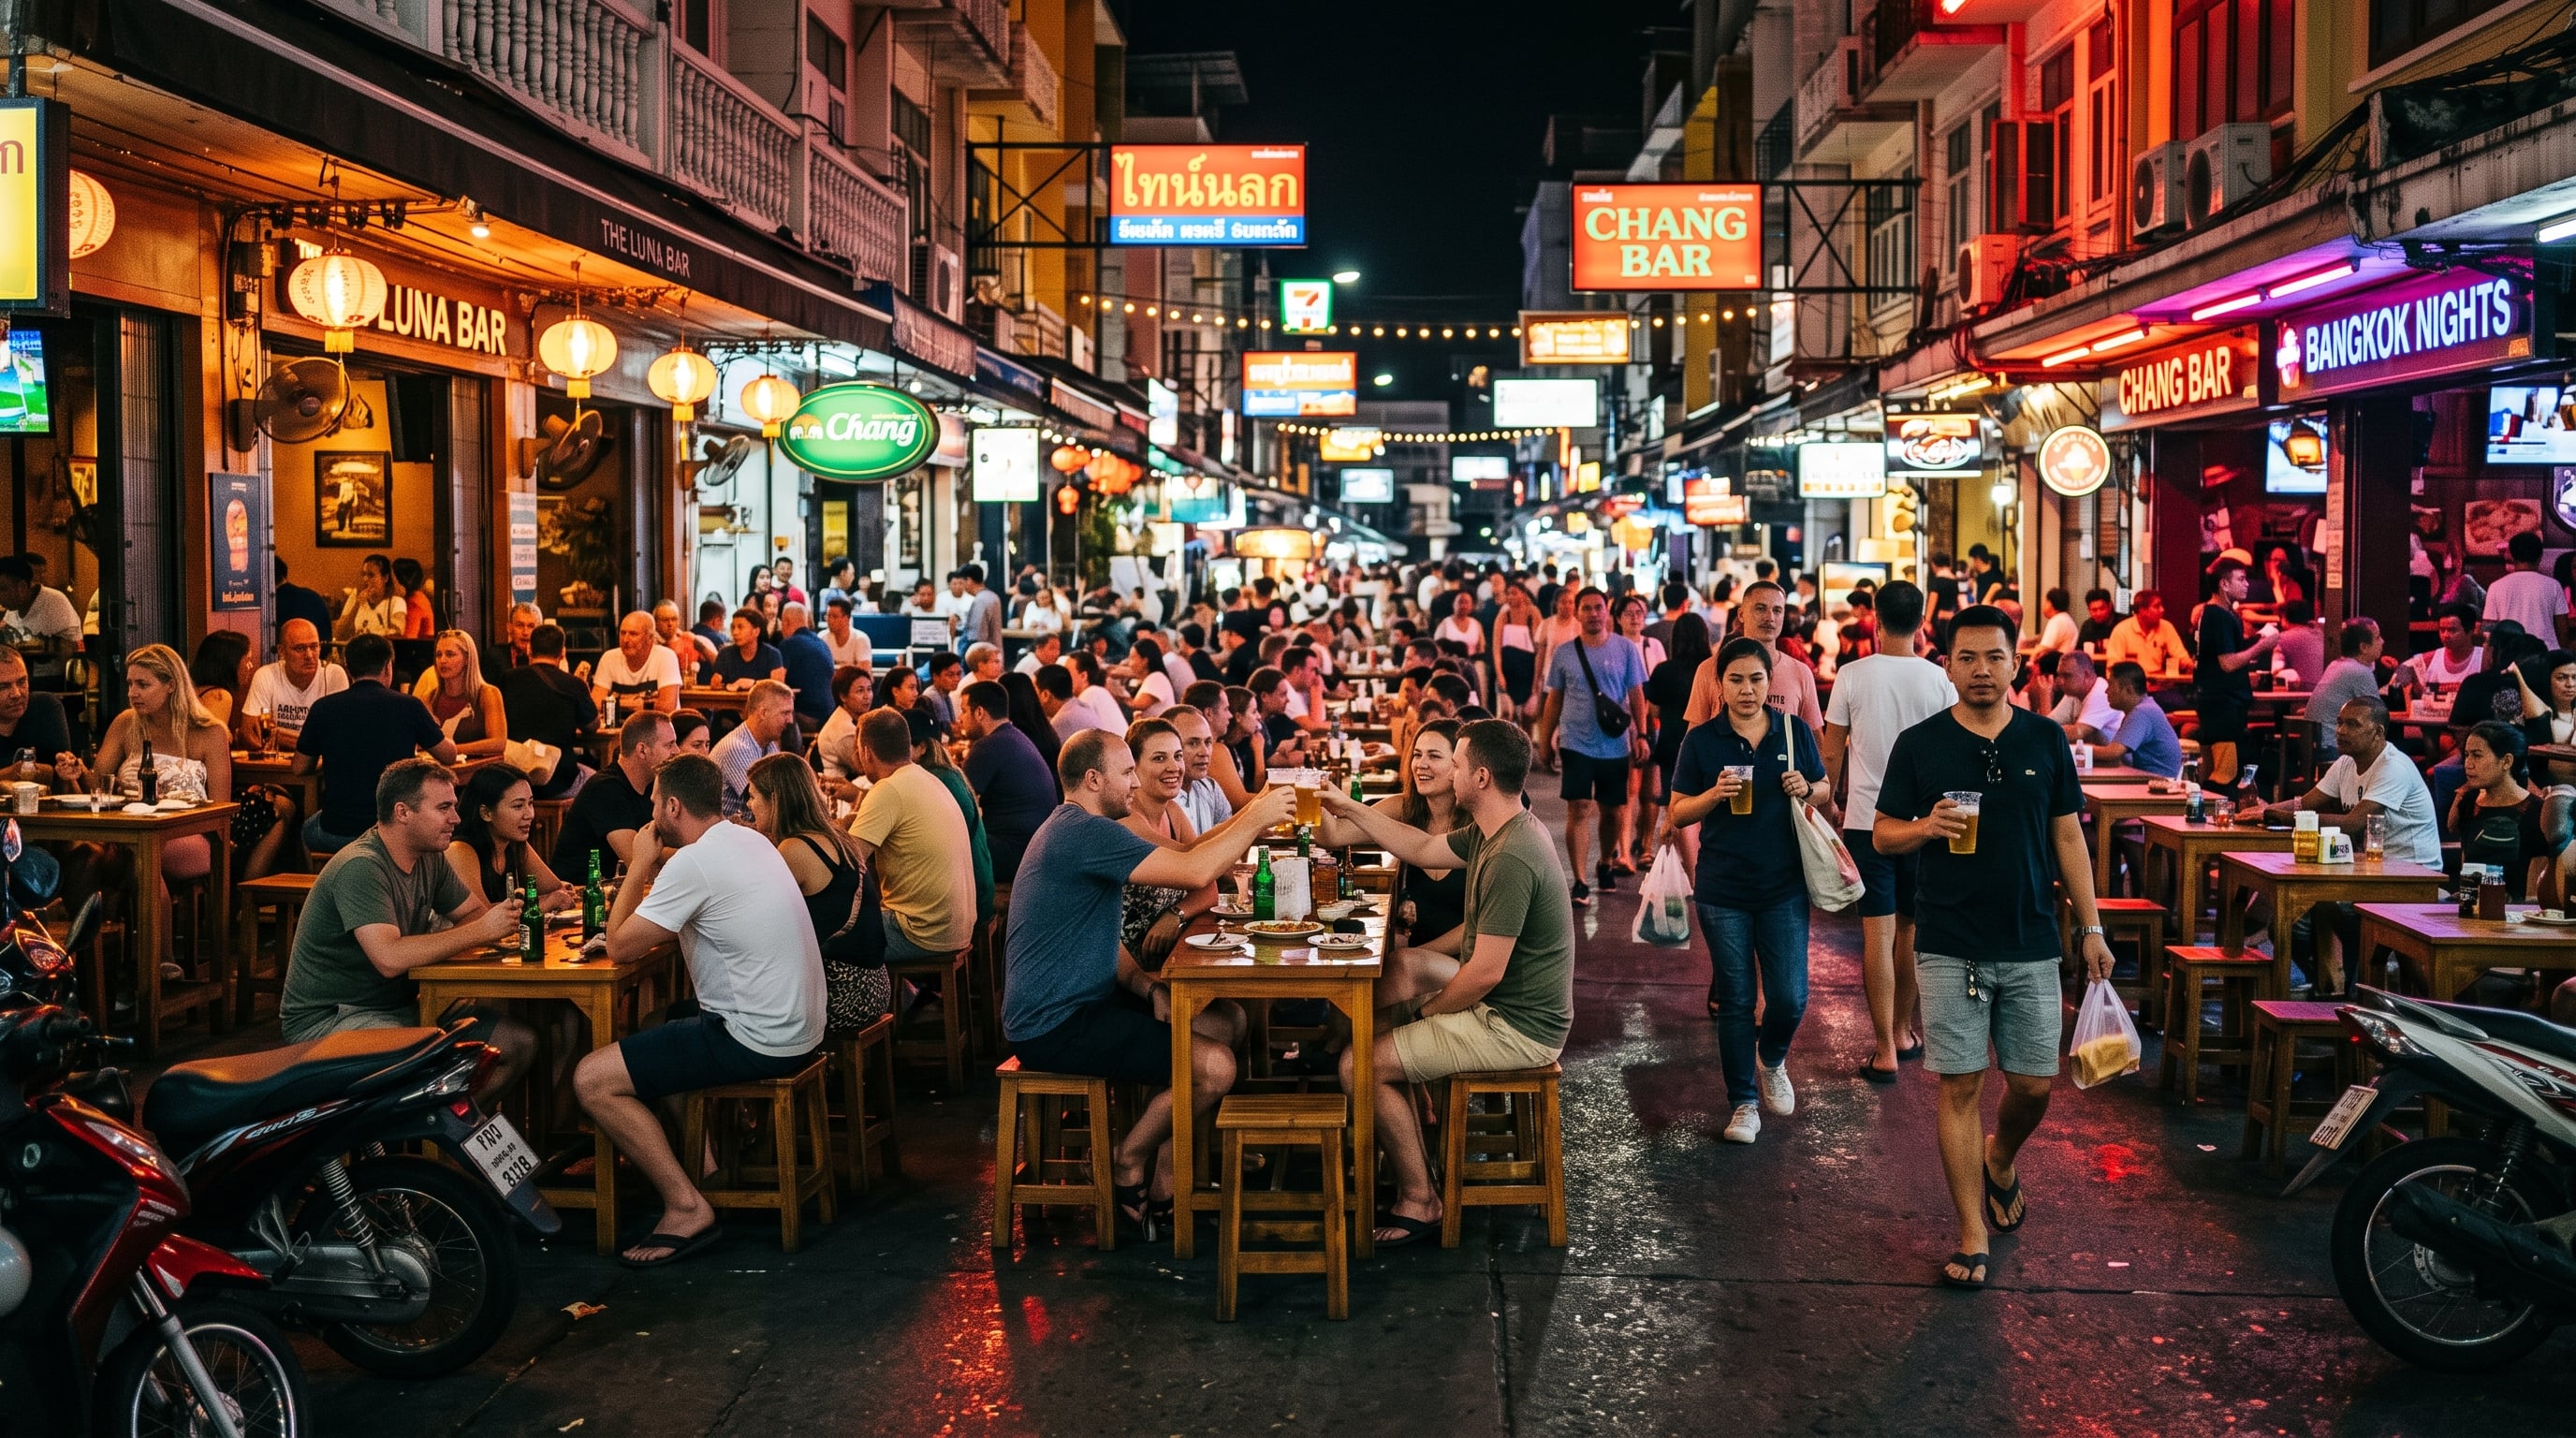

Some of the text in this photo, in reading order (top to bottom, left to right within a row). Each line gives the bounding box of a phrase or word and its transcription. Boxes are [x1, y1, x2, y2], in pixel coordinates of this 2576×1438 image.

[601, 218, 690, 278] THE LUNA BAR
[1585, 207, 1748, 242] CHANG
[1620, 243, 1713, 277] BAR
[378, 284, 451, 345] LUNA
[457, 301, 506, 356] BAR
[2305, 278, 2510, 373] BANGKOK NIGHTS
[2119, 345, 2232, 415] CHANG BAR
[826, 412, 917, 447] Chang
